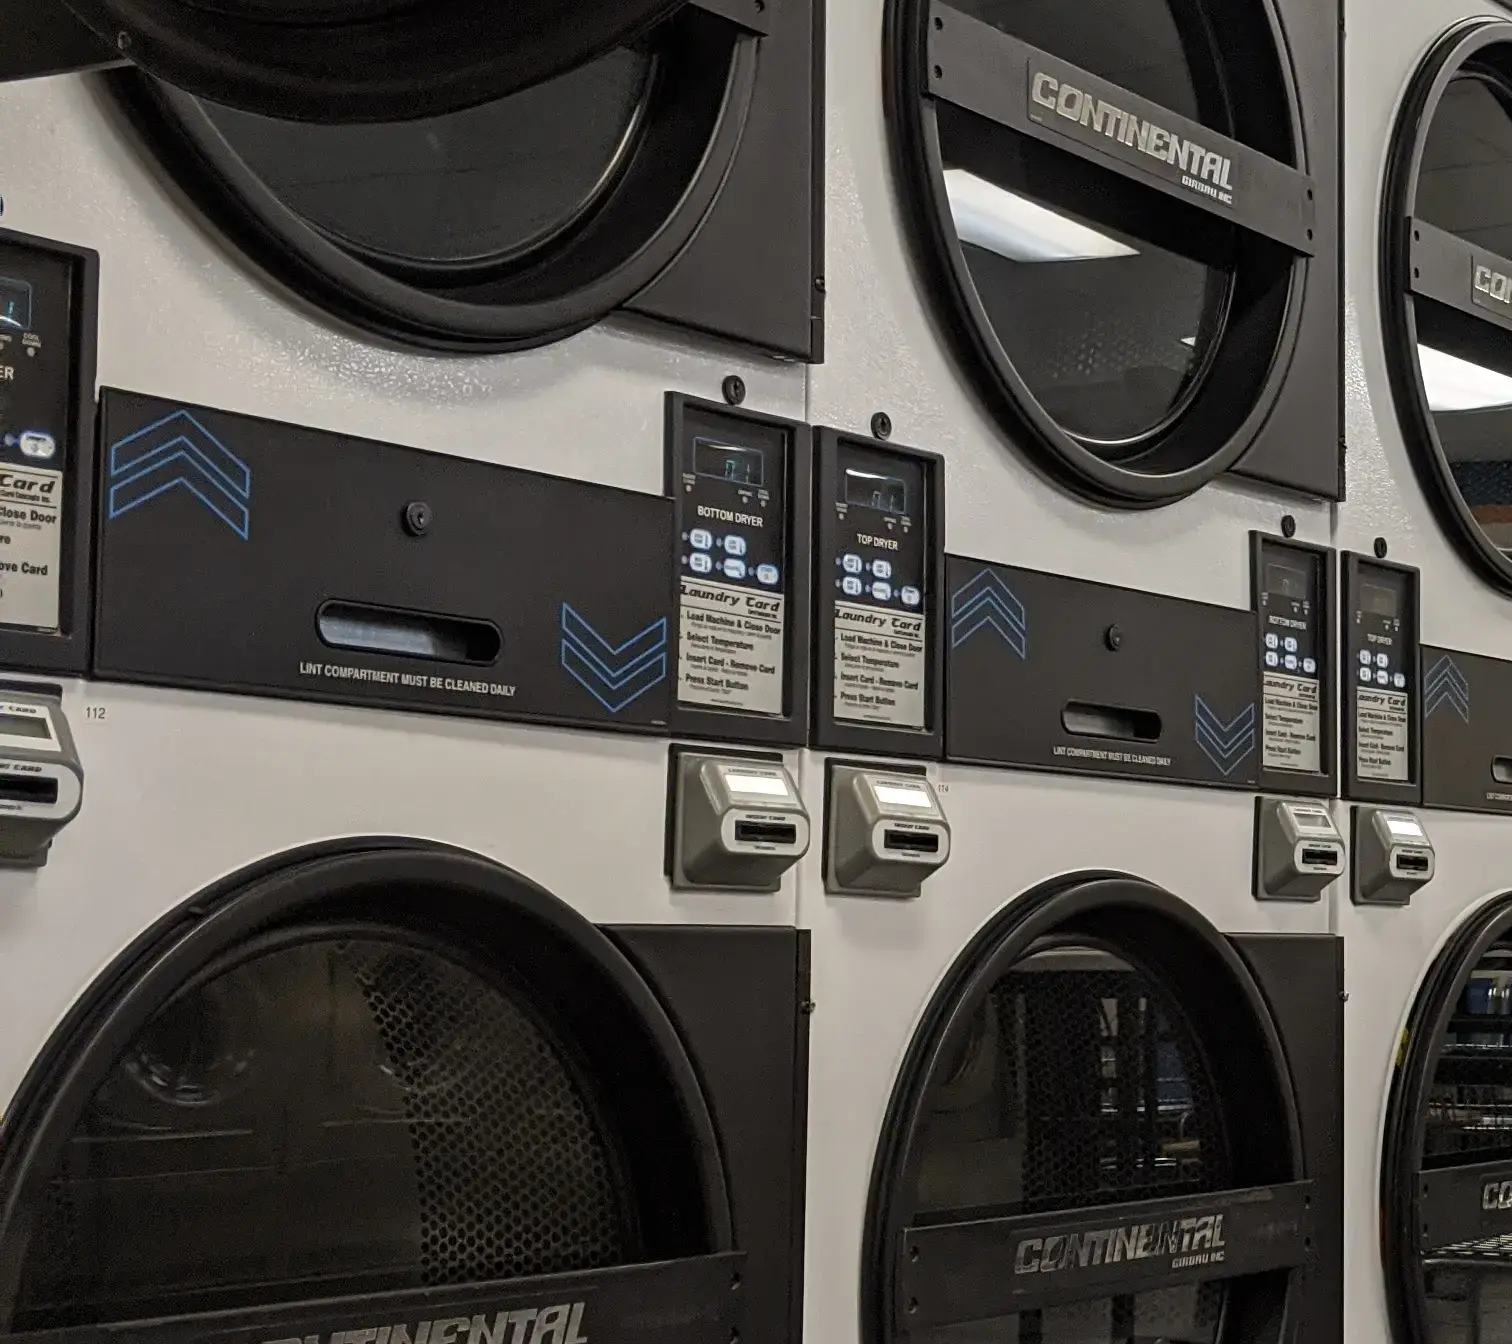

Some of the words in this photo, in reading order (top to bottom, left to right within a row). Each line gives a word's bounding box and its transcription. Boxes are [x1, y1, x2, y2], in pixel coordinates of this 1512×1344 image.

[1032, 72, 1233, 190] CONTINENTAL
[30, 510, 56, 523] Door
[697, 505, 733, 521] BOTTOM
[735, 513, 763, 527] DRYER
[857, 533, 873, 545] TOP
[873, 537, 898, 550] DRYER
[21, 562, 48, 575] Card
[680, 584, 740, 606] Laundry
[745, 596, 780, 612] Card
[835, 609, 886, 627] Laundry
[300, 662, 324, 676] LINT
[324, 665, 399, 683] COMPARTMENT
[401, 673, 428, 687] MUST
[430, 677, 443, 688] BE
[445, 679, 489, 694] CLEANED
[490, 684, 516, 696] DAILY
[86, 707, 106, 719] 112
[1014, 1214, 1225, 1274] CONTINENTAL
